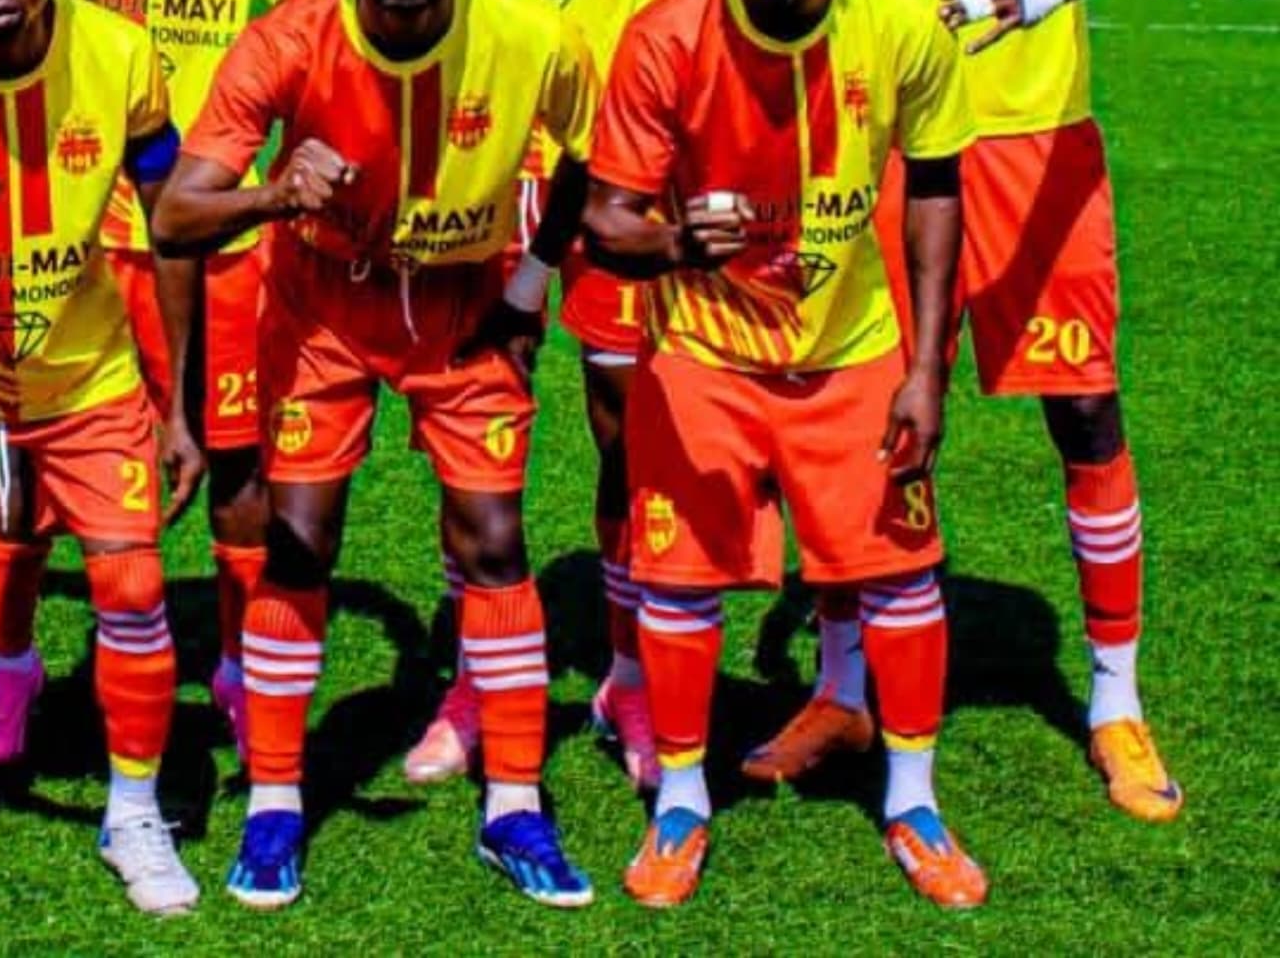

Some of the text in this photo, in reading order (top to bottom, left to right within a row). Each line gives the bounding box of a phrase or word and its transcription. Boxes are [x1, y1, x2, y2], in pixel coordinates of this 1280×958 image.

[1025, 315, 1091, 366] 20
[485, 414, 517, 461] 6
[120, 459, 150, 512] 2
[904, 480, 932, 531] 8
